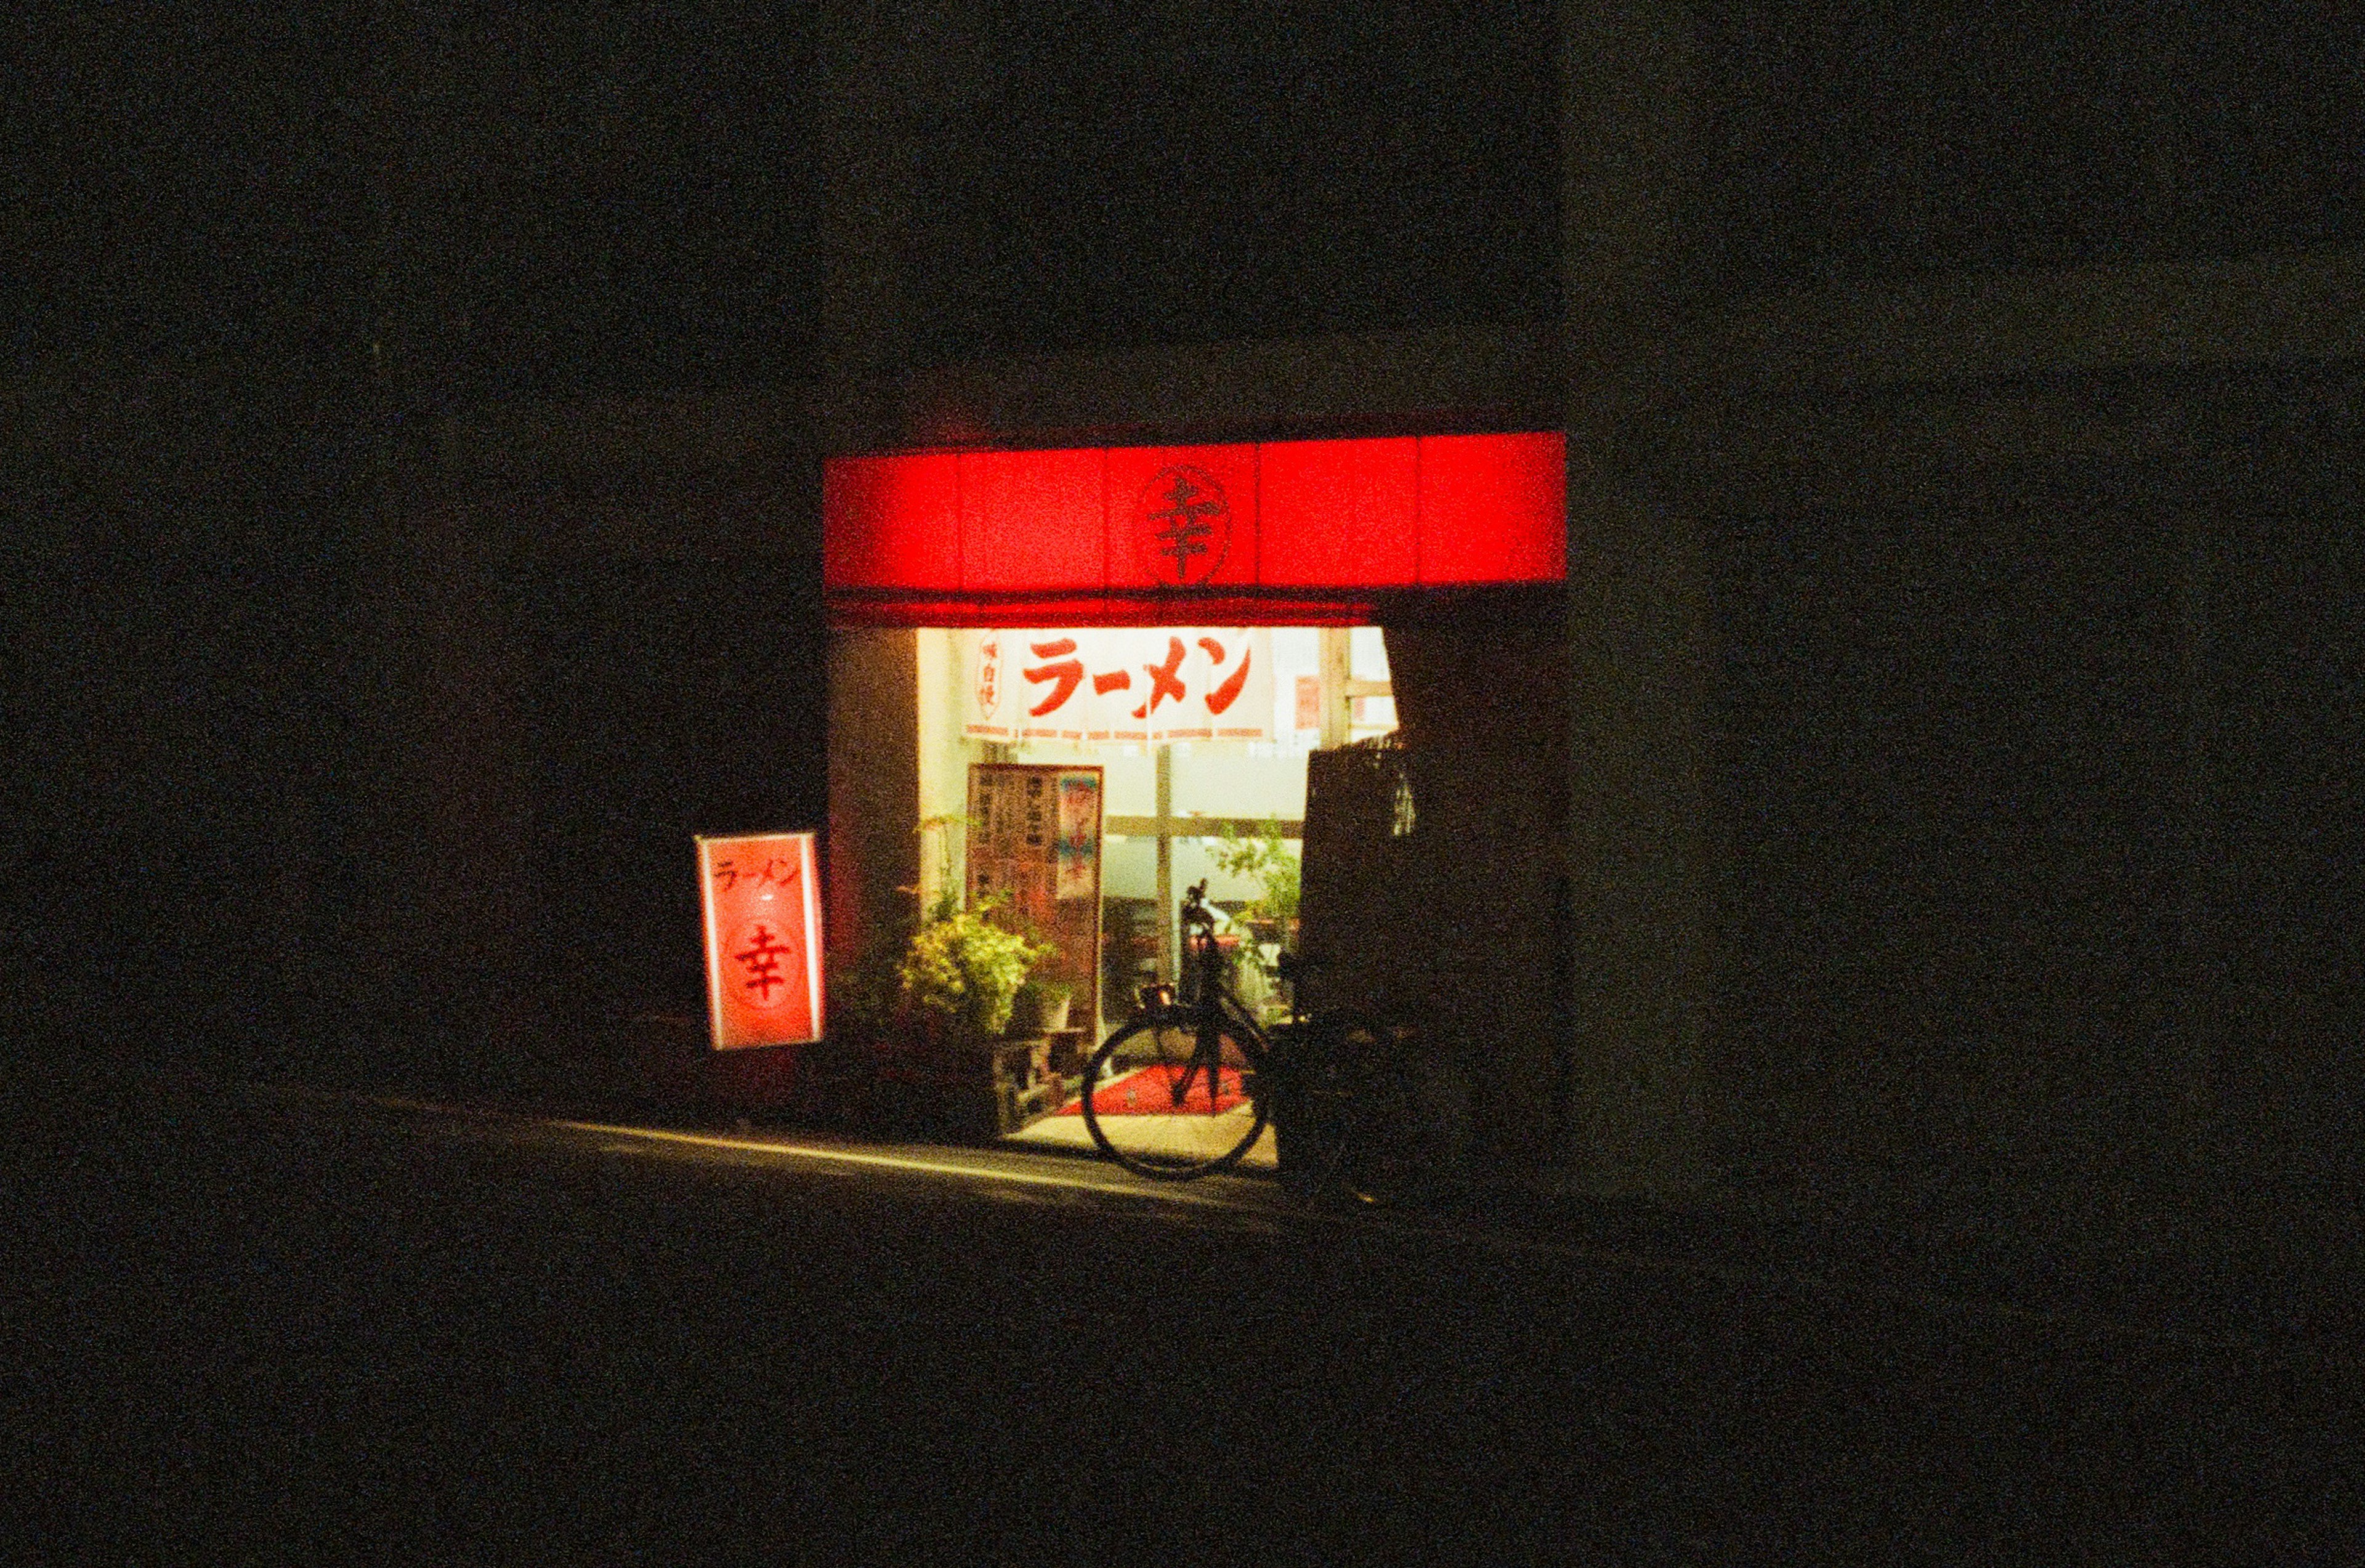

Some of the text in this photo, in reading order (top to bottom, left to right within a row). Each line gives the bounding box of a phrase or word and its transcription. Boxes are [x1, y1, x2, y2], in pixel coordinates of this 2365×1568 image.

[1148, 477, 1220, 578] 幸
[1022, 637, 1250, 719] ラーメン
[714, 860, 799, 892] ラーメン
[735, 925, 790, 1001] 幸
